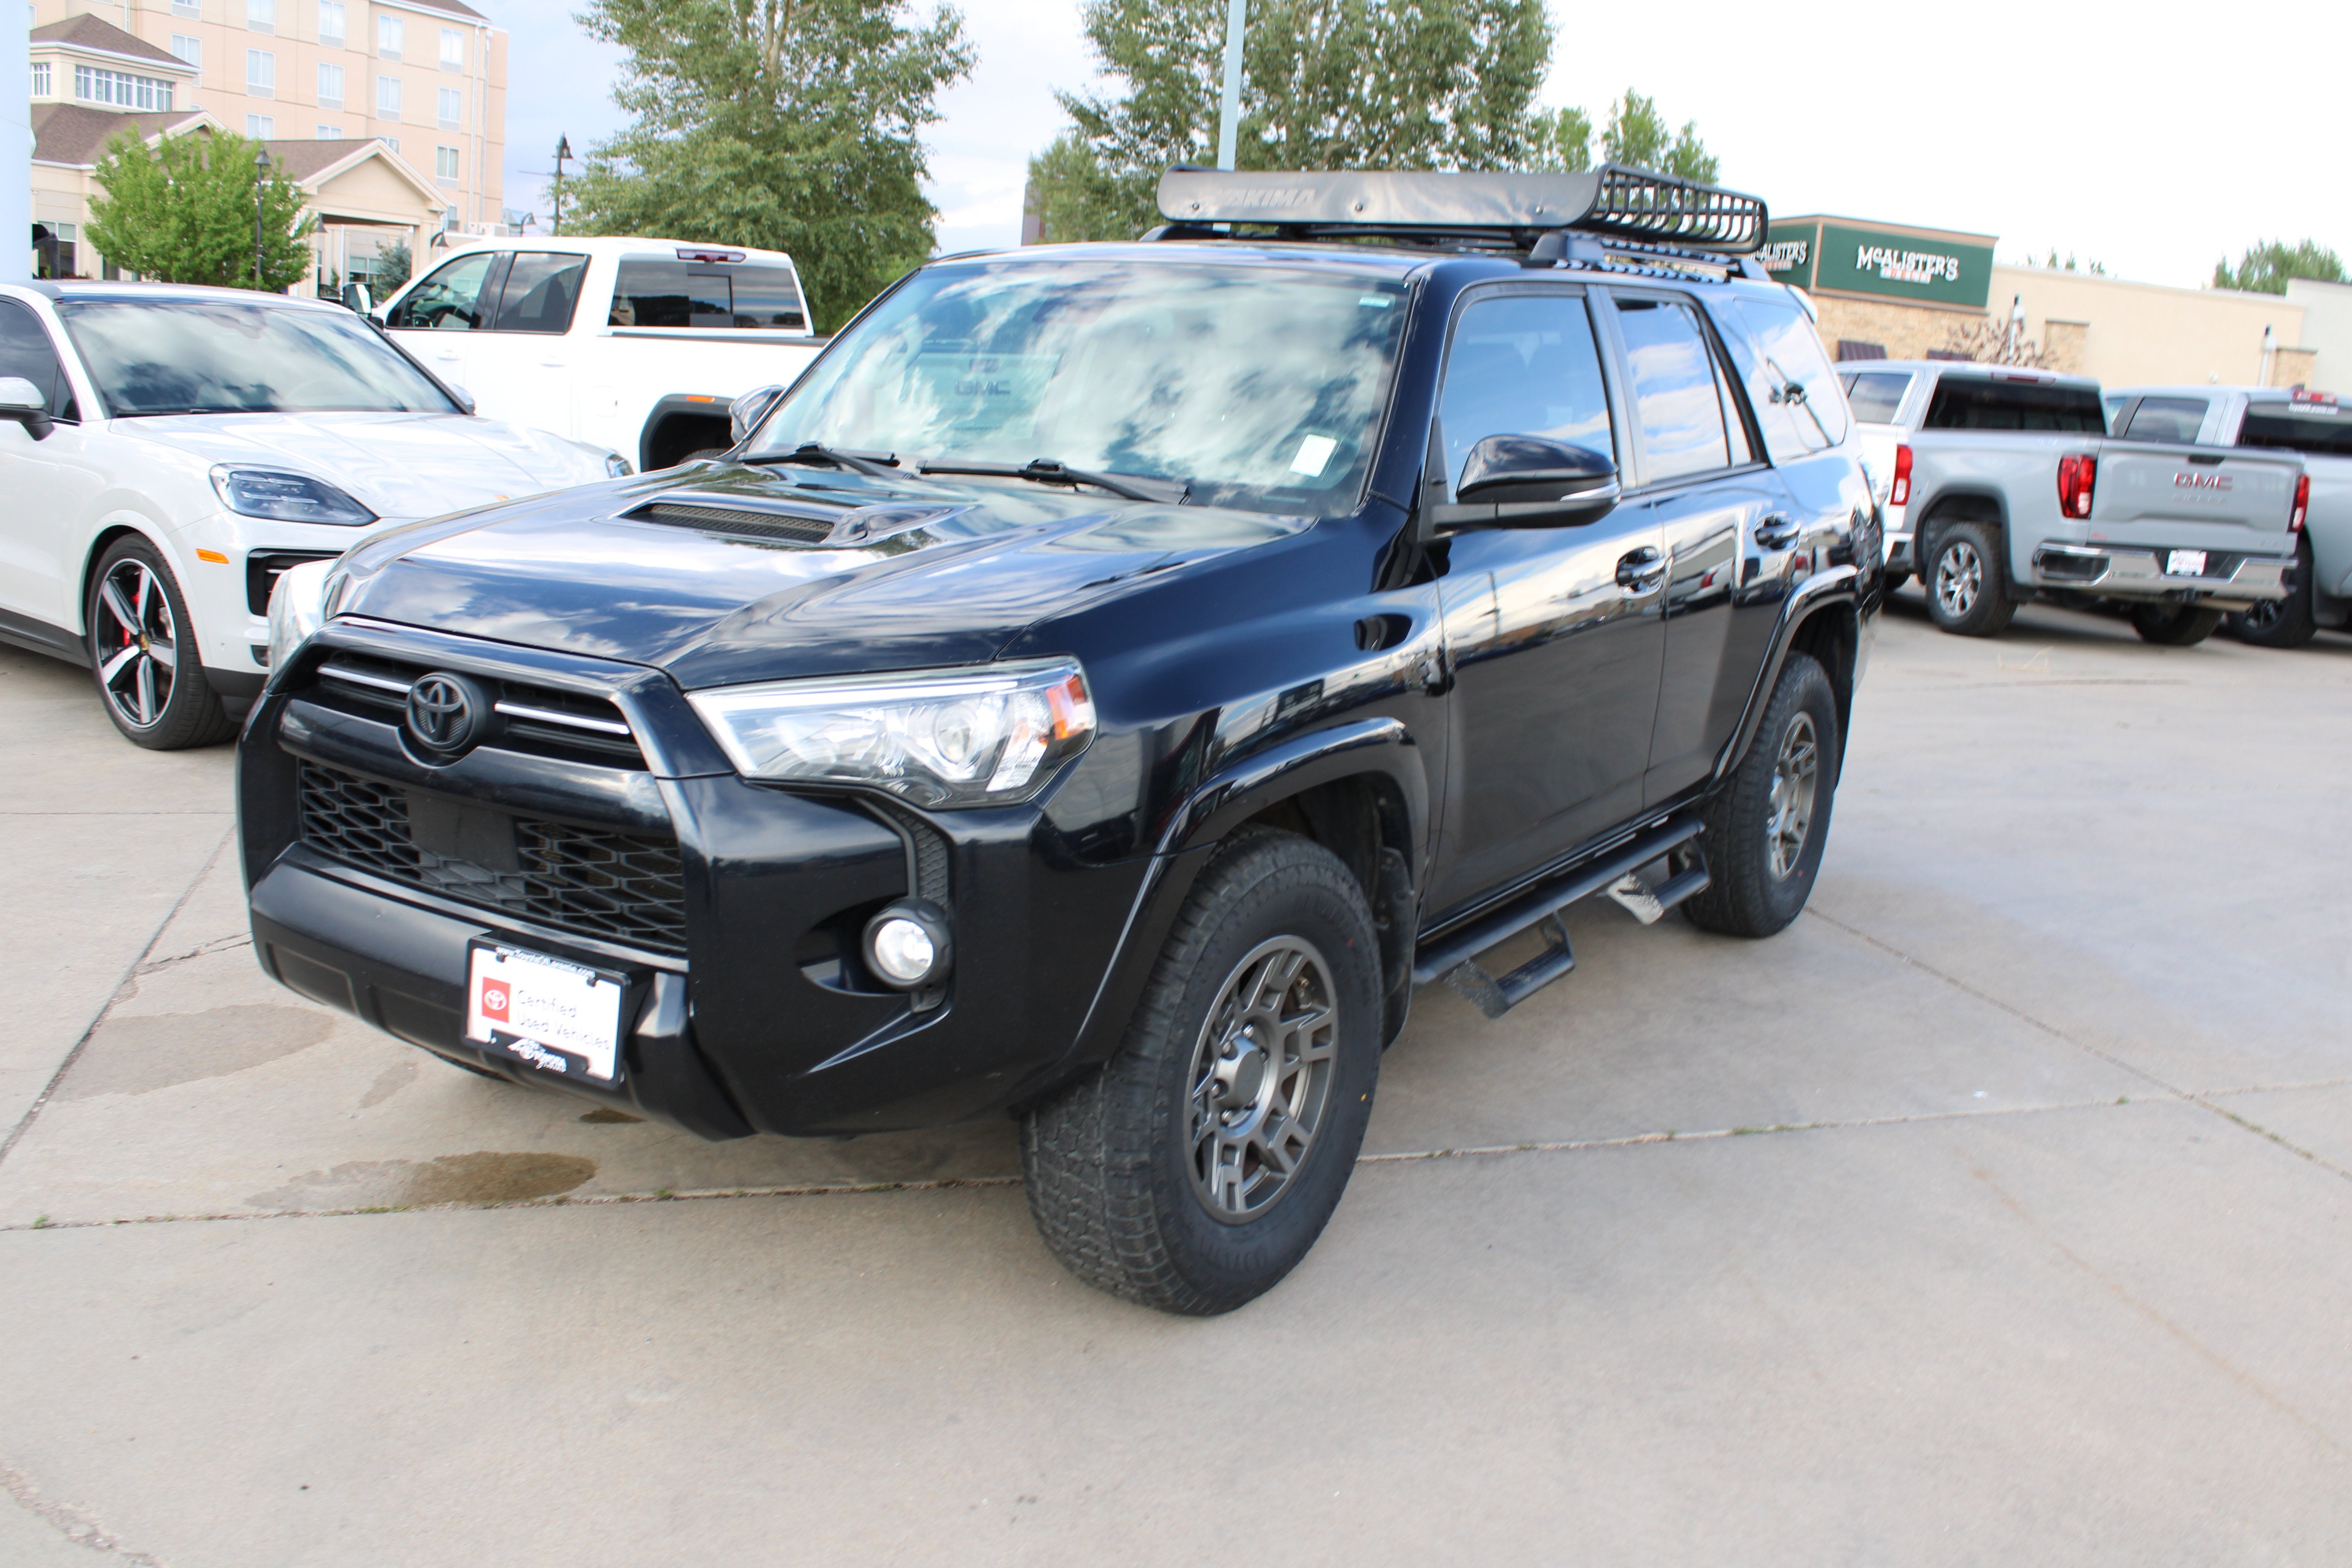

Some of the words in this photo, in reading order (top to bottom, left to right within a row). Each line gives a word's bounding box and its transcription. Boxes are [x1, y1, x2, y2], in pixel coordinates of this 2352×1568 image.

[1216, 188, 1316, 207] YAKIMA
[955, 380, 1011, 395] GMC
[2173, 472, 2233, 491] GMC
[518, 989, 578, 1018] Certified
[517, 1011, 550, 1033] Used
[555, 1021, 610, 1050] Vehicles
